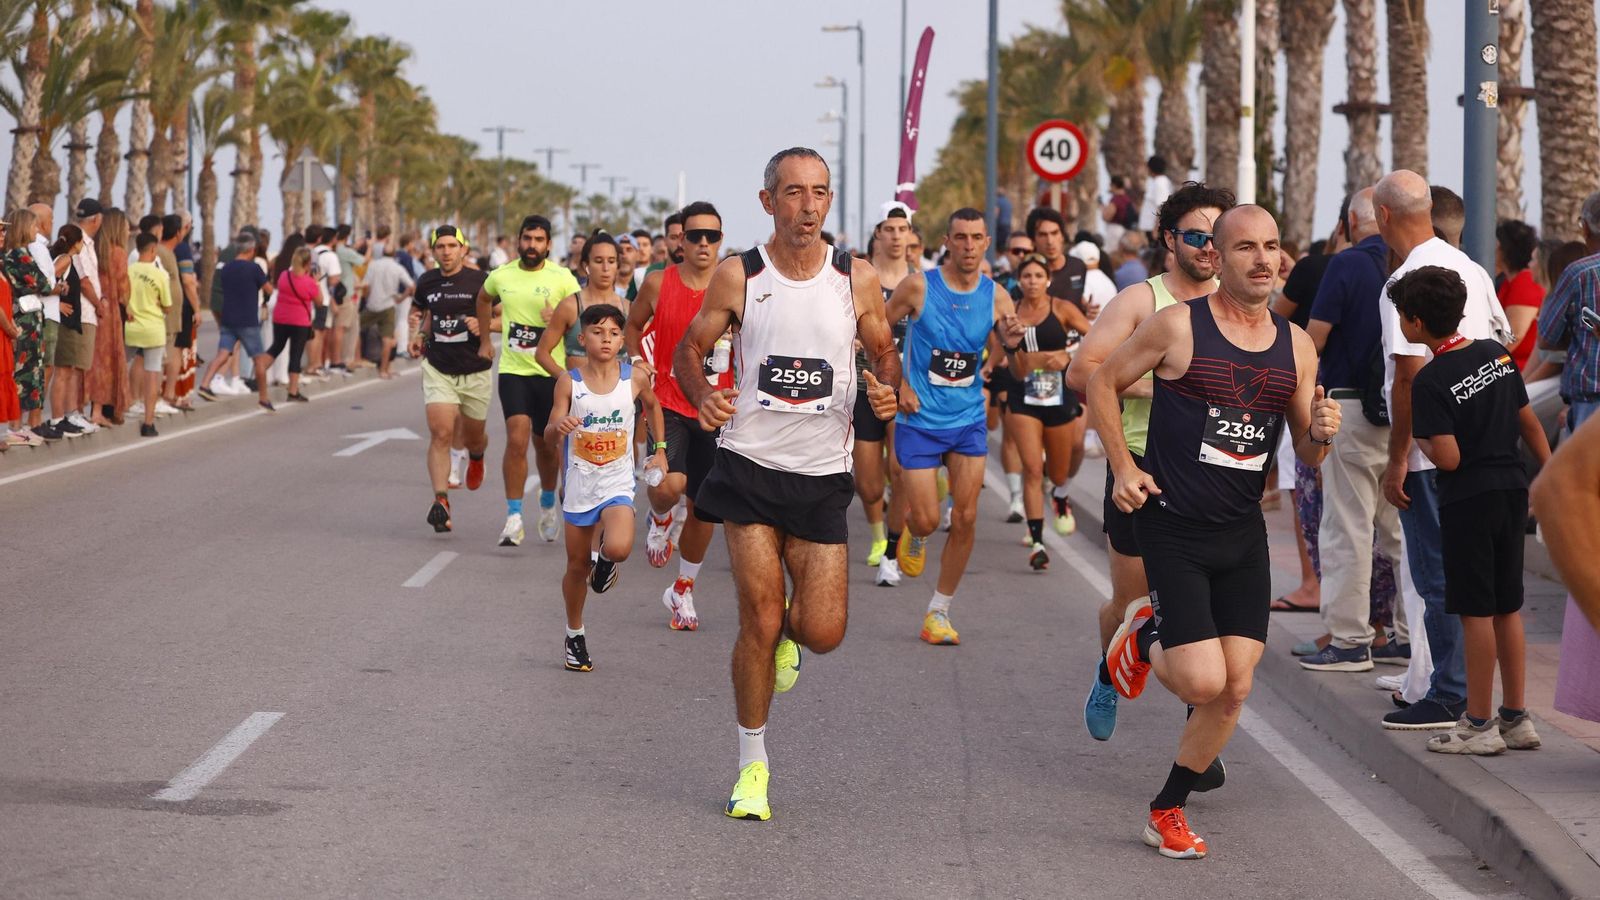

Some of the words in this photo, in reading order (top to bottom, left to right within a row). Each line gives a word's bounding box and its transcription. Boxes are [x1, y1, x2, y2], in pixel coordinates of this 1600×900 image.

[1041, 140, 1071, 161] 40
[440, 319, 459, 328] 957
[516, 329, 537, 340] 929
[944, 358, 967, 370] 719
[770, 367, 823, 386] 2596
[1450, 358, 1504, 396] POLICIA
[1455, 364, 1516, 404] NACIONAL
[1216, 420, 1266, 441] 2384
[584, 440, 616, 452] 4611
